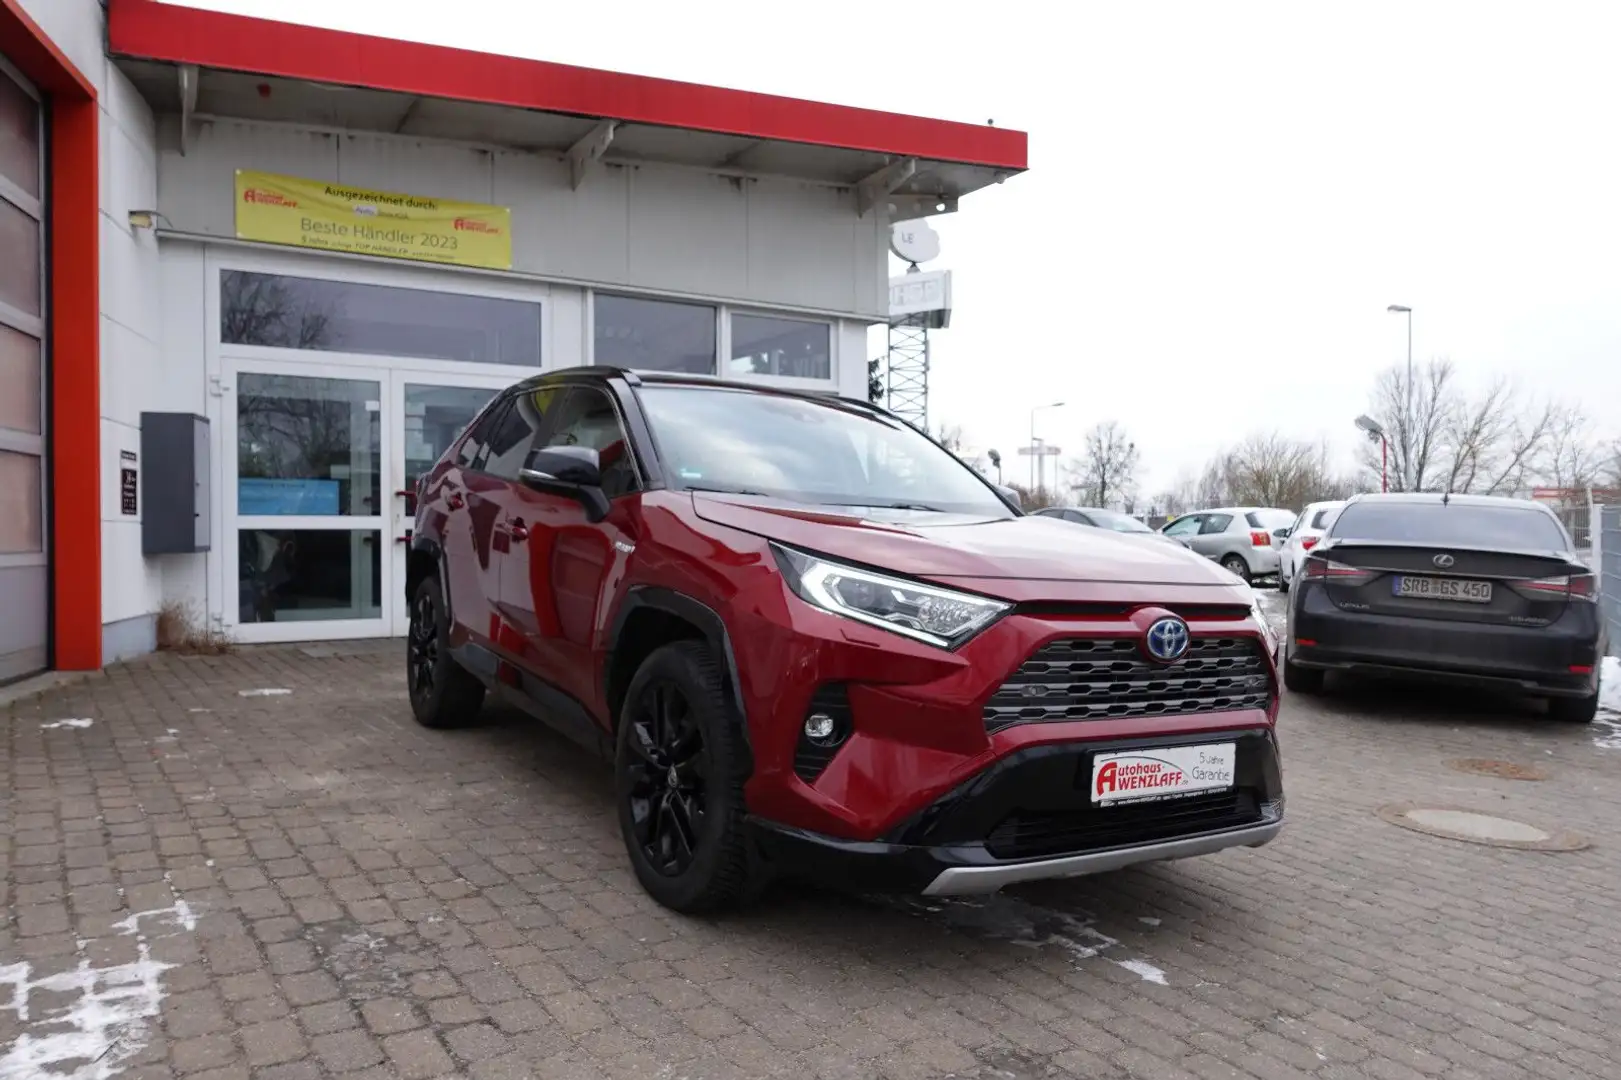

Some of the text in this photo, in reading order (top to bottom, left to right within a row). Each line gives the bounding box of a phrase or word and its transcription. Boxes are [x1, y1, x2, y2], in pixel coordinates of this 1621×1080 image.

[324, 186, 438, 211] Ausgezeichnet durch:
[301, 218, 348, 234] Beste
[353, 223, 415, 245] Händler
[420, 233, 458, 250] 2023
[1402, 577, 1490, 598] SRB GS 450
[1191, 766, 1231, 781] Garantie
